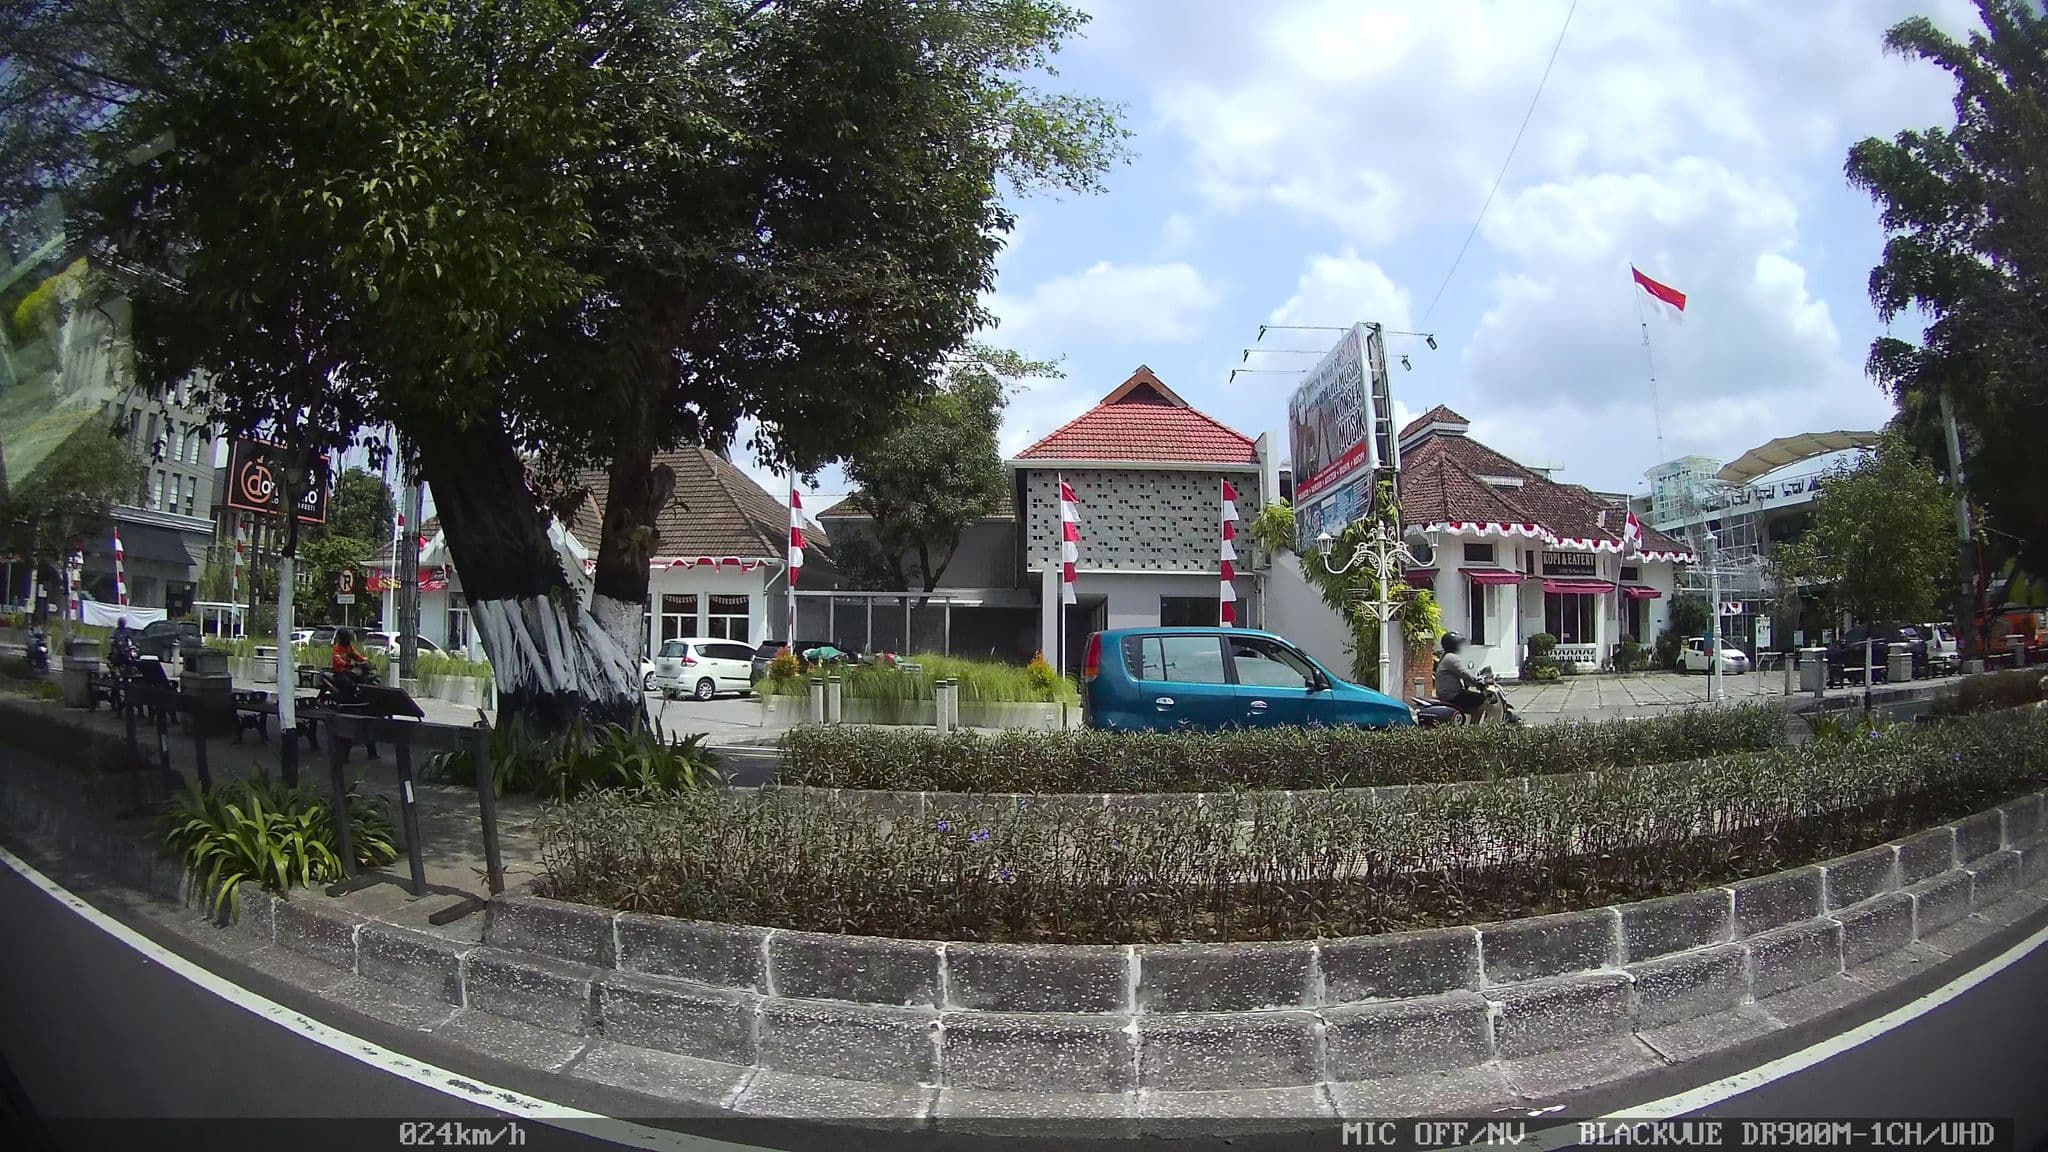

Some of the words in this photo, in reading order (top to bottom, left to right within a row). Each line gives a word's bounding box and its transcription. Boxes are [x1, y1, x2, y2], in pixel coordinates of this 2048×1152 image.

[1338, 409, 1367, 452] MUSIK
[1543, 552, 1560, 565] KOPI
[1568, 553, 1595, 566] EATERY
